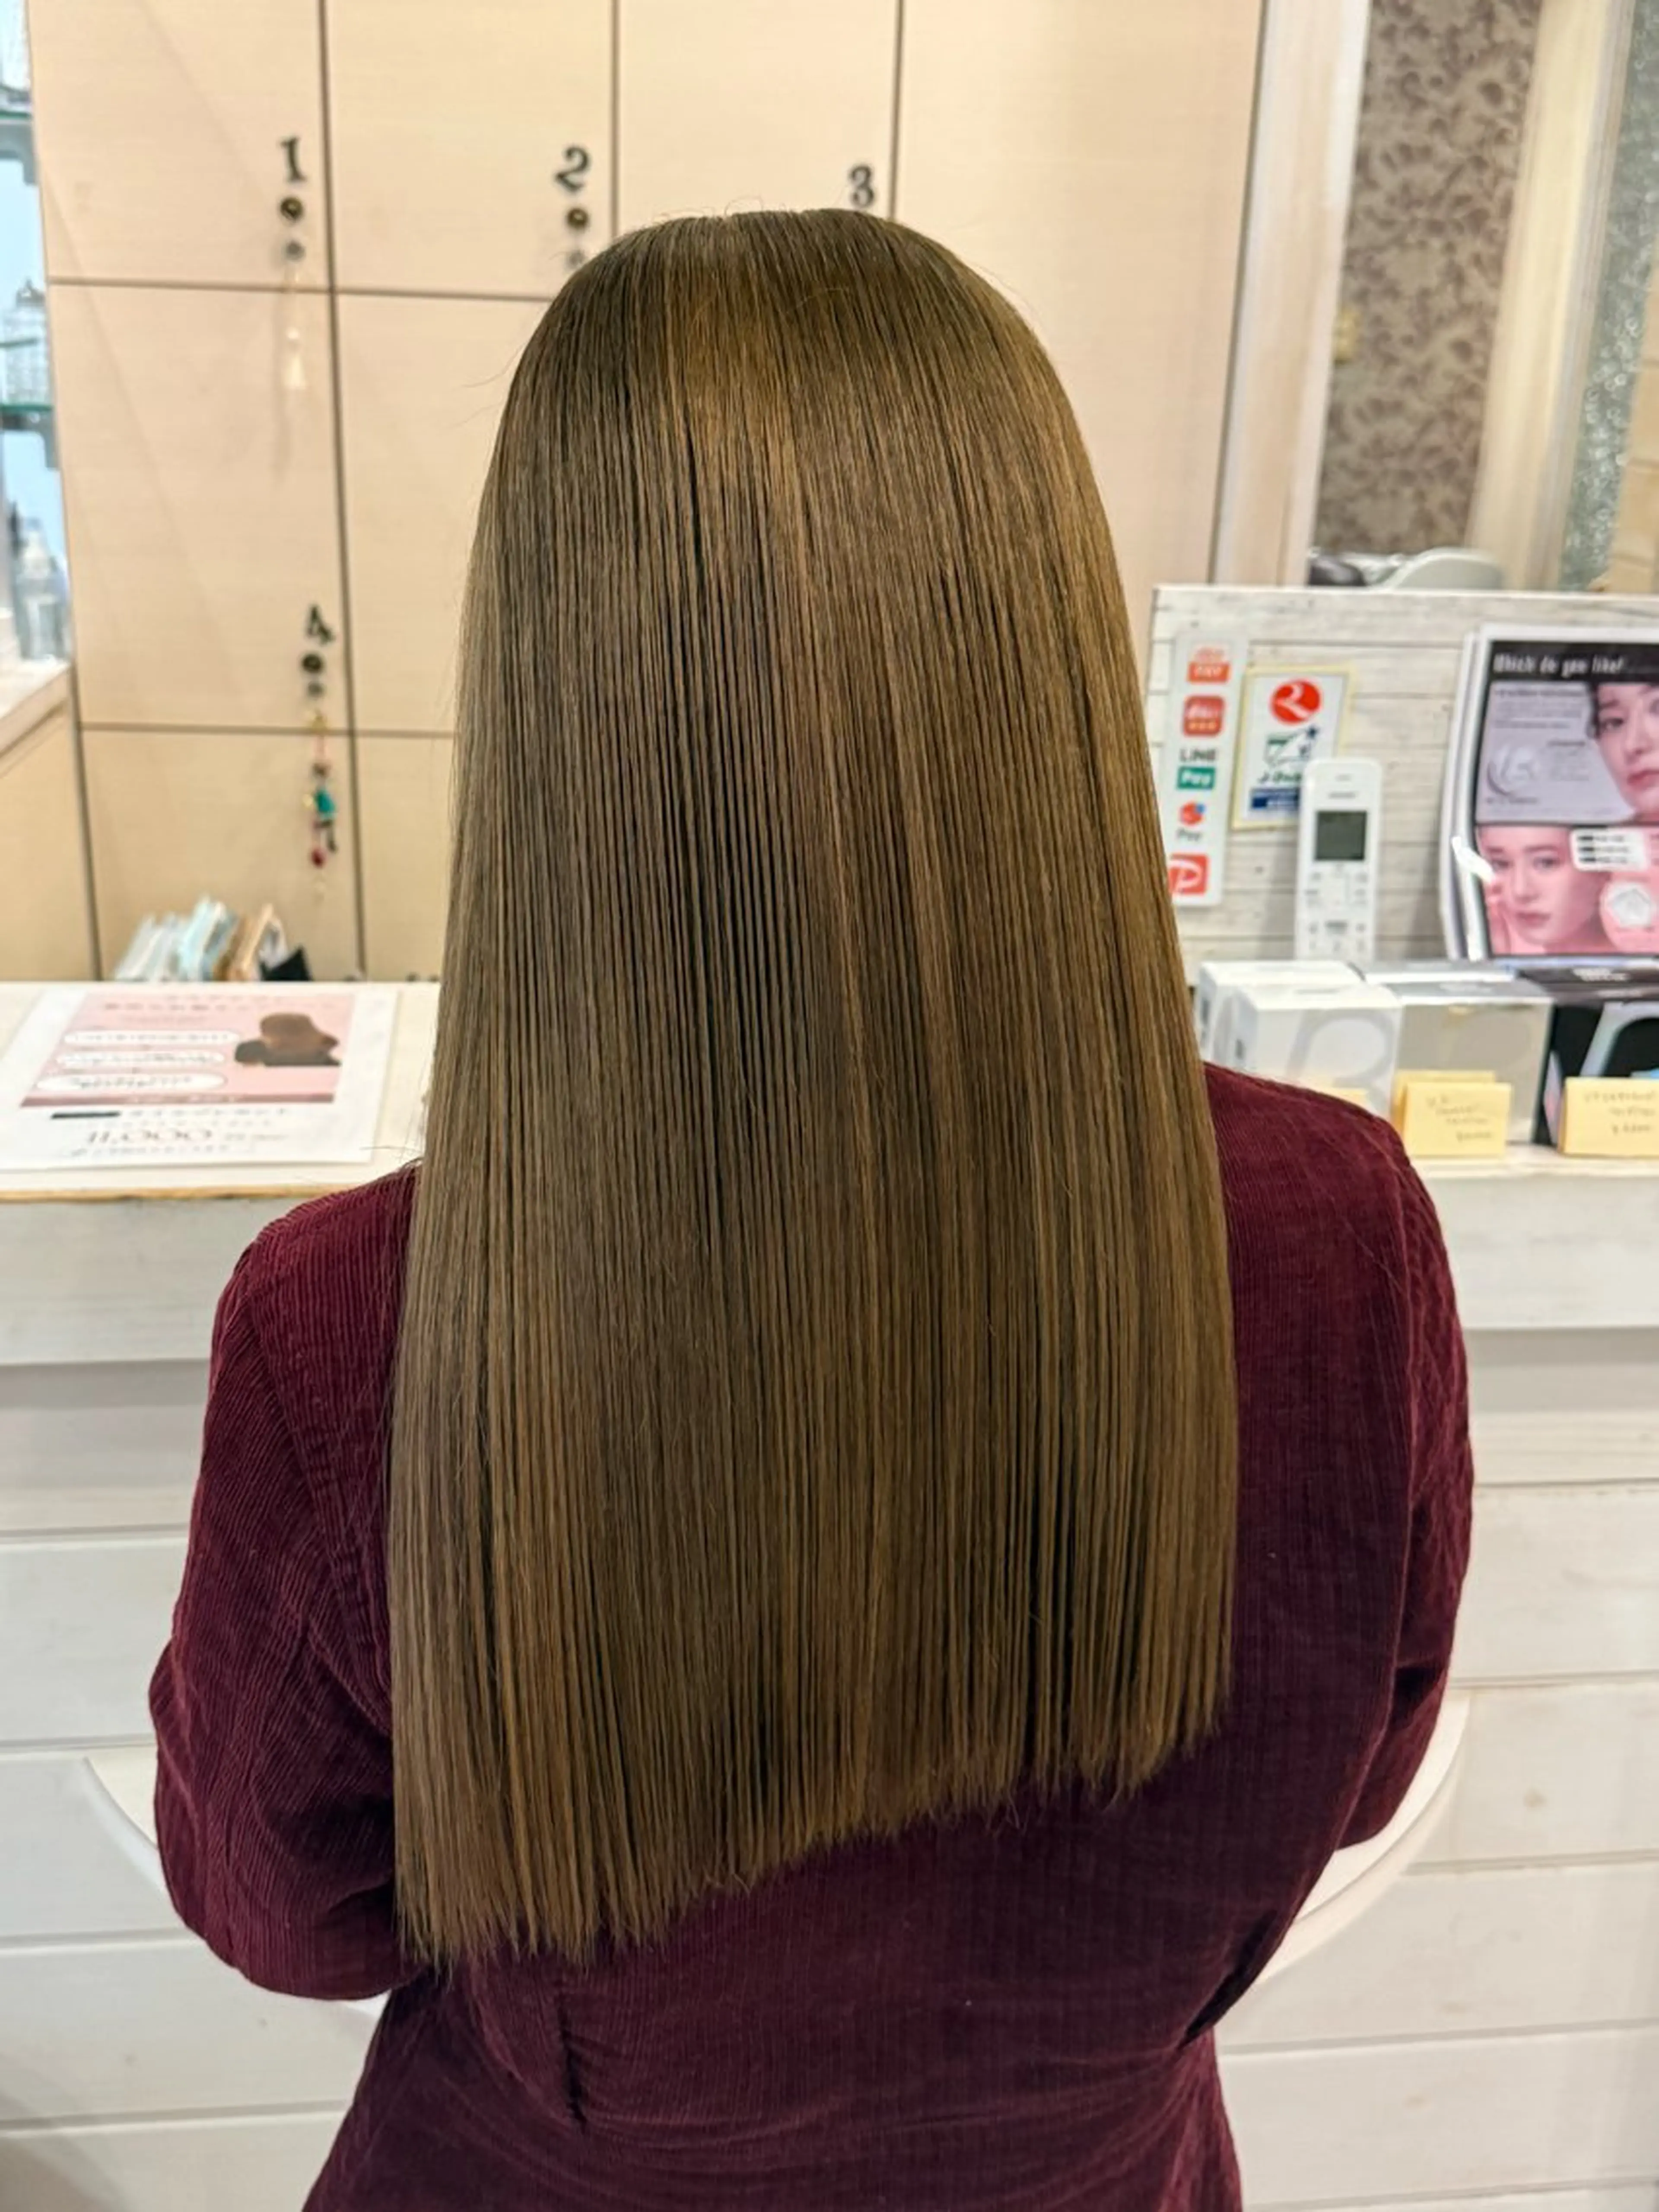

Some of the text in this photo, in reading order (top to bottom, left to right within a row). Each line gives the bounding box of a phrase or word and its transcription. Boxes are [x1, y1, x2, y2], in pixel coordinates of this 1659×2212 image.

[279, 136, 308, 183] 1
[553, 145, 590, 193] 2
[849, 163, 874, 209] 3
[306, 604, 334, 645] 4
